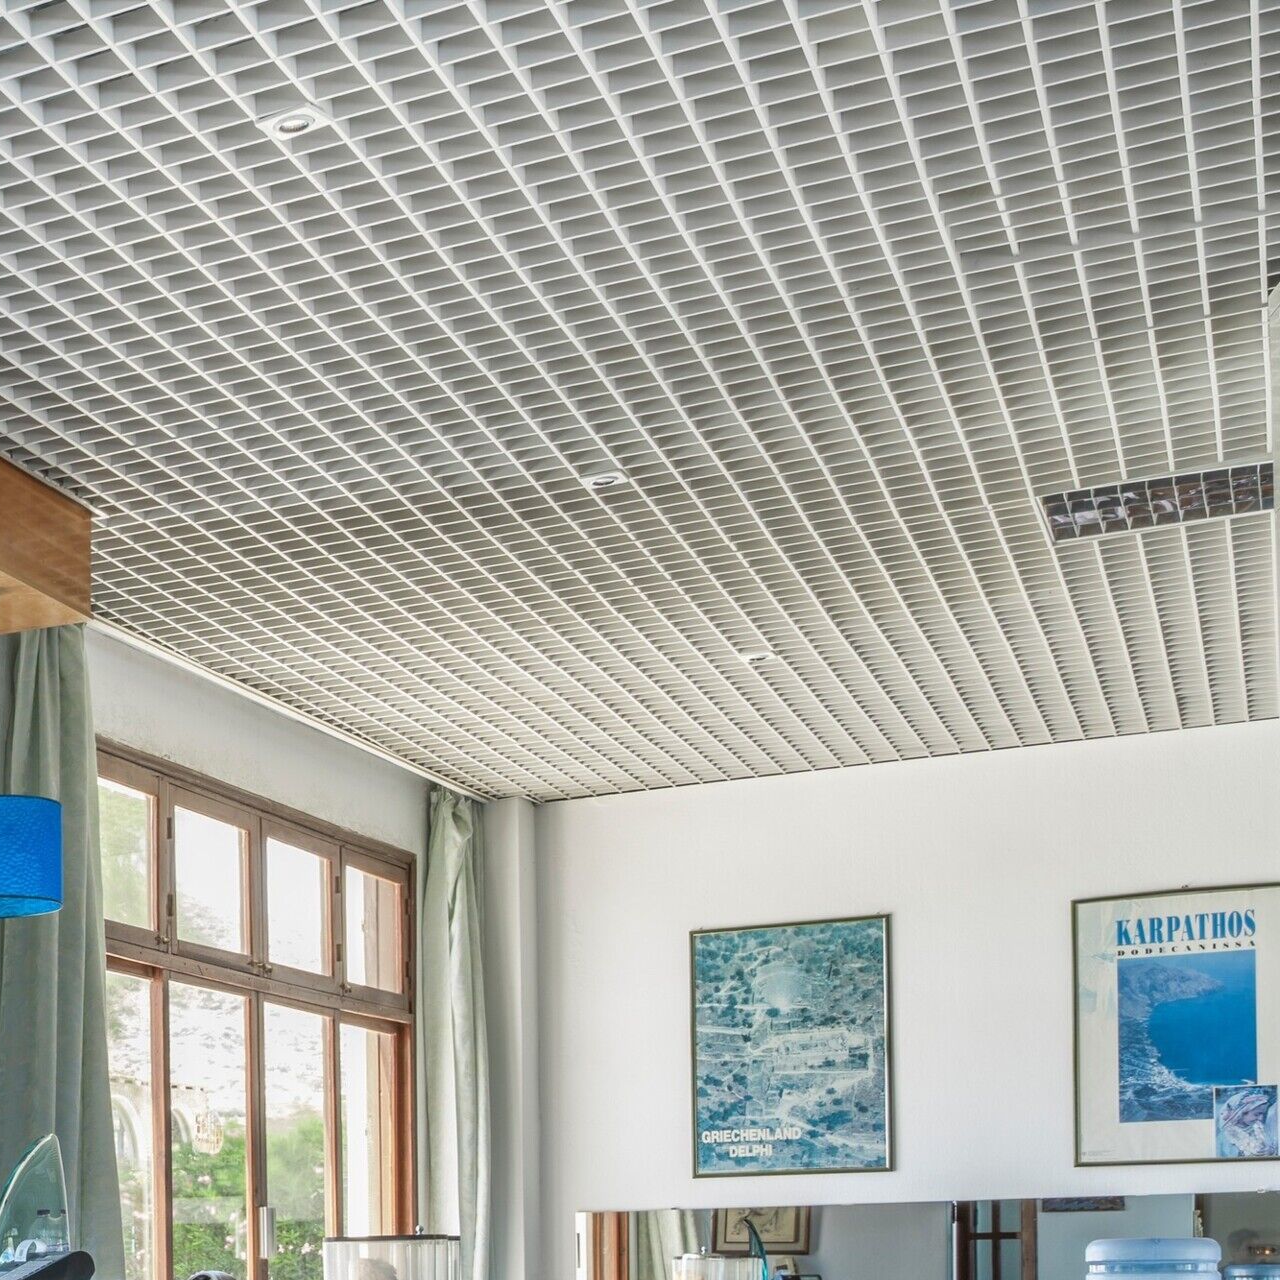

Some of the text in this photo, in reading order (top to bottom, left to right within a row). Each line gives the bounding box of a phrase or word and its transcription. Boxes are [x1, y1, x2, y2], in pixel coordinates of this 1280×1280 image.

[1115, 908, 1257, 947] KARPATHOS
[1117, 940, 1256, 957] DODECANISSA
[701, 1127, 802, 1144] GRIECHENLAND
[729, 1144, 773, 1158] DELPHI
